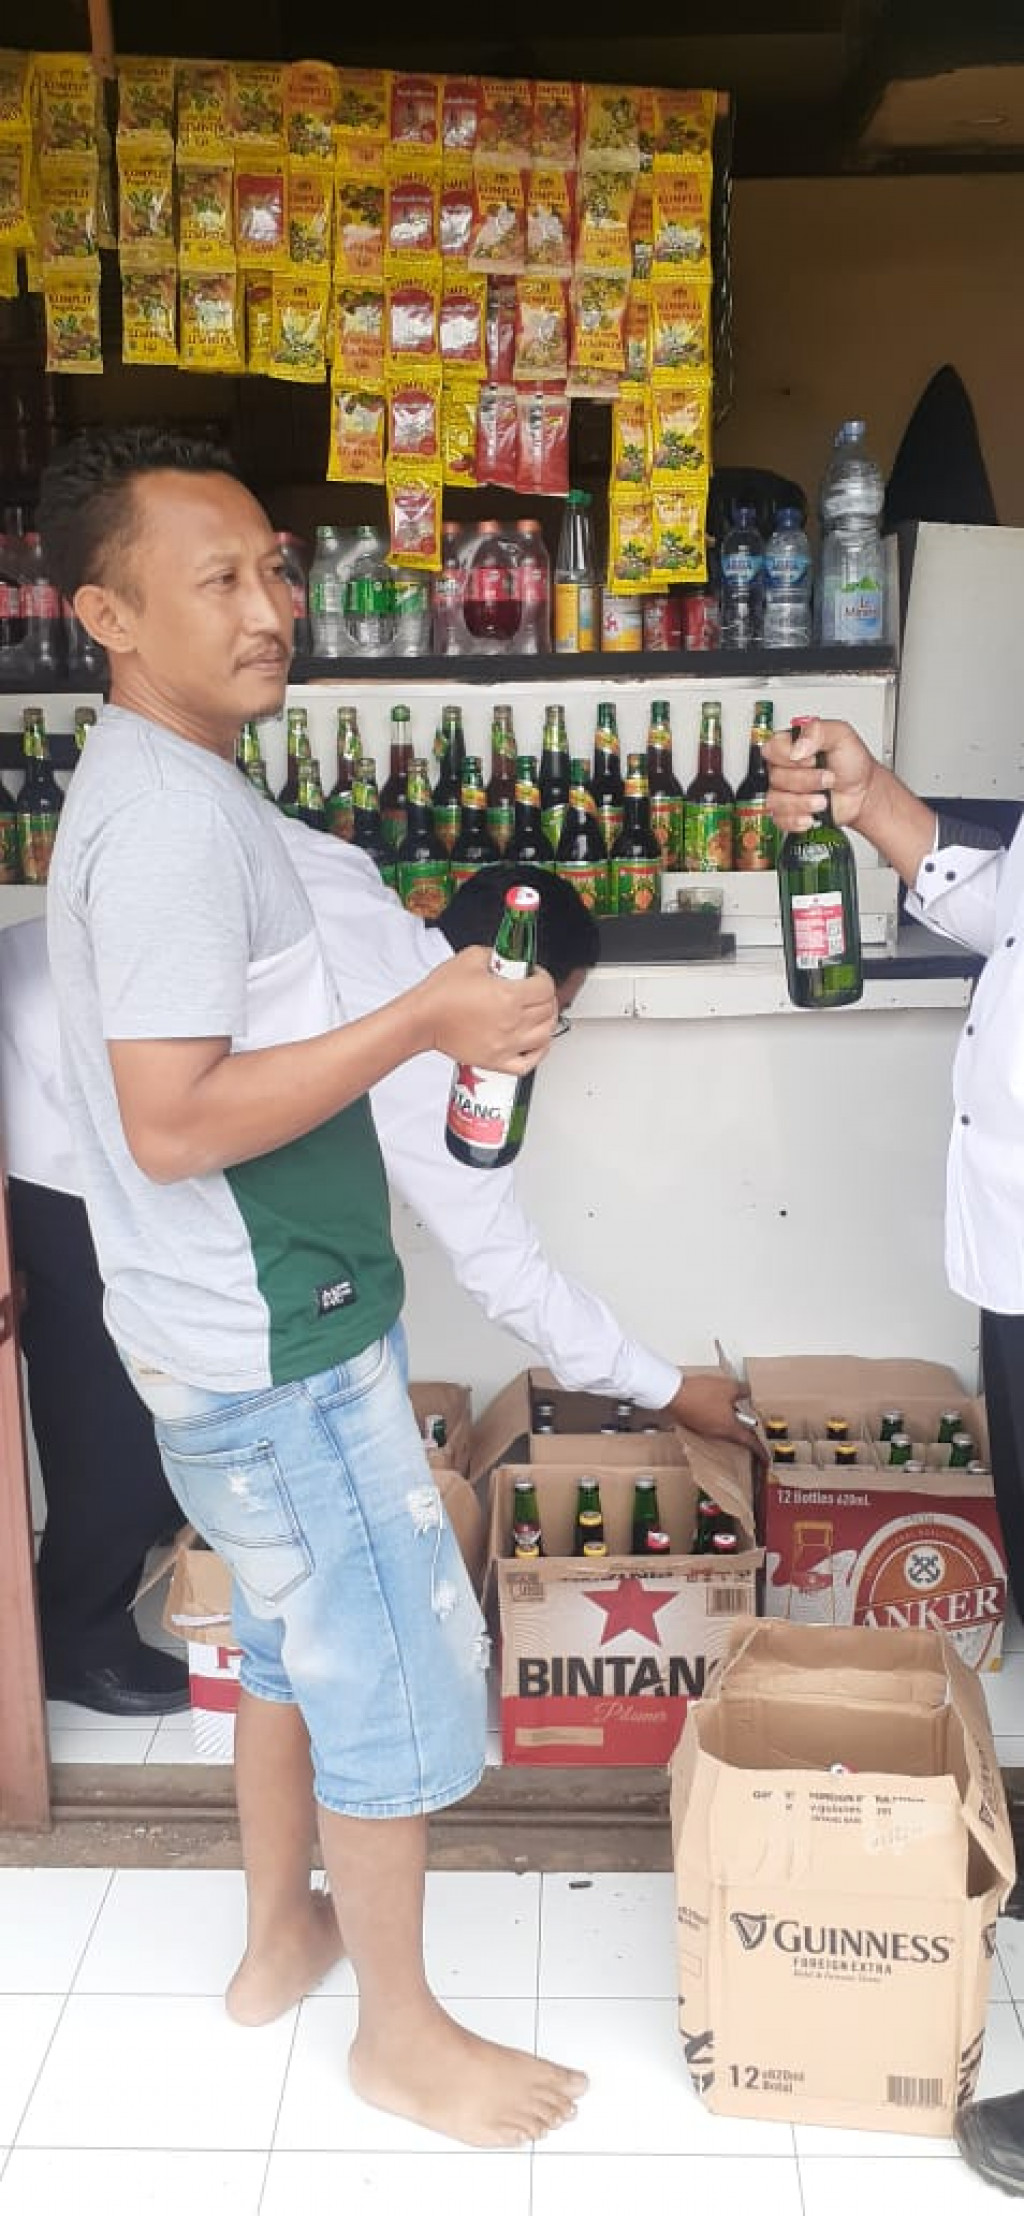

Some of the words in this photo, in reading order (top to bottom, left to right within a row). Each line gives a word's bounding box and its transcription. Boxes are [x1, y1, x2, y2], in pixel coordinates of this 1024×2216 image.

[776, 1488, 791, 1504] 12
[793, 1488, 833, 1504] Bottles
[518, 1656, 719, 1699] BINTAN
[773, 1919, 950, 1964] GUINNESS
[793, 1957, 848, 1971] FOREIGN
[851, 1960, 892, 1976] EXTRA
[728, 2063, 759, 2090] 12
